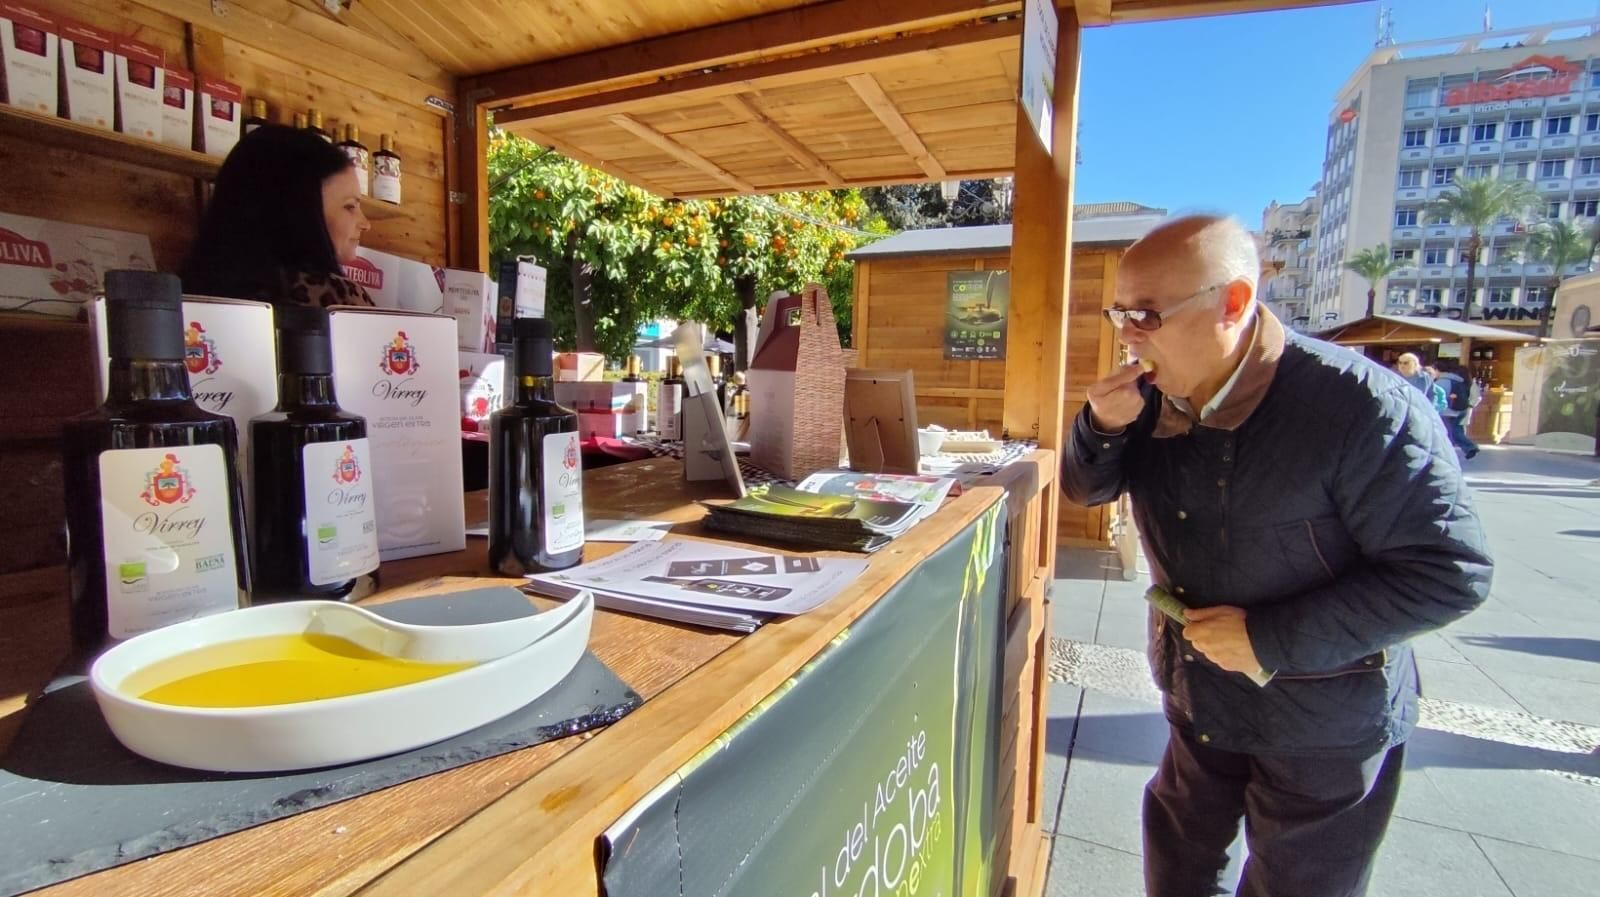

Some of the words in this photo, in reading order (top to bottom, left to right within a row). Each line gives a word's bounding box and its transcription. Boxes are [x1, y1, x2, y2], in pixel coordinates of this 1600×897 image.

[371, 377, 427, 407] Virrey
[327, 485, 367, 507] Virrey
[132, 505, 207, 538] Virrey
[834, 801, 868, 888] del
[872, 729, 926, 829] Aceite
[853, 761, 941, 897] doba
